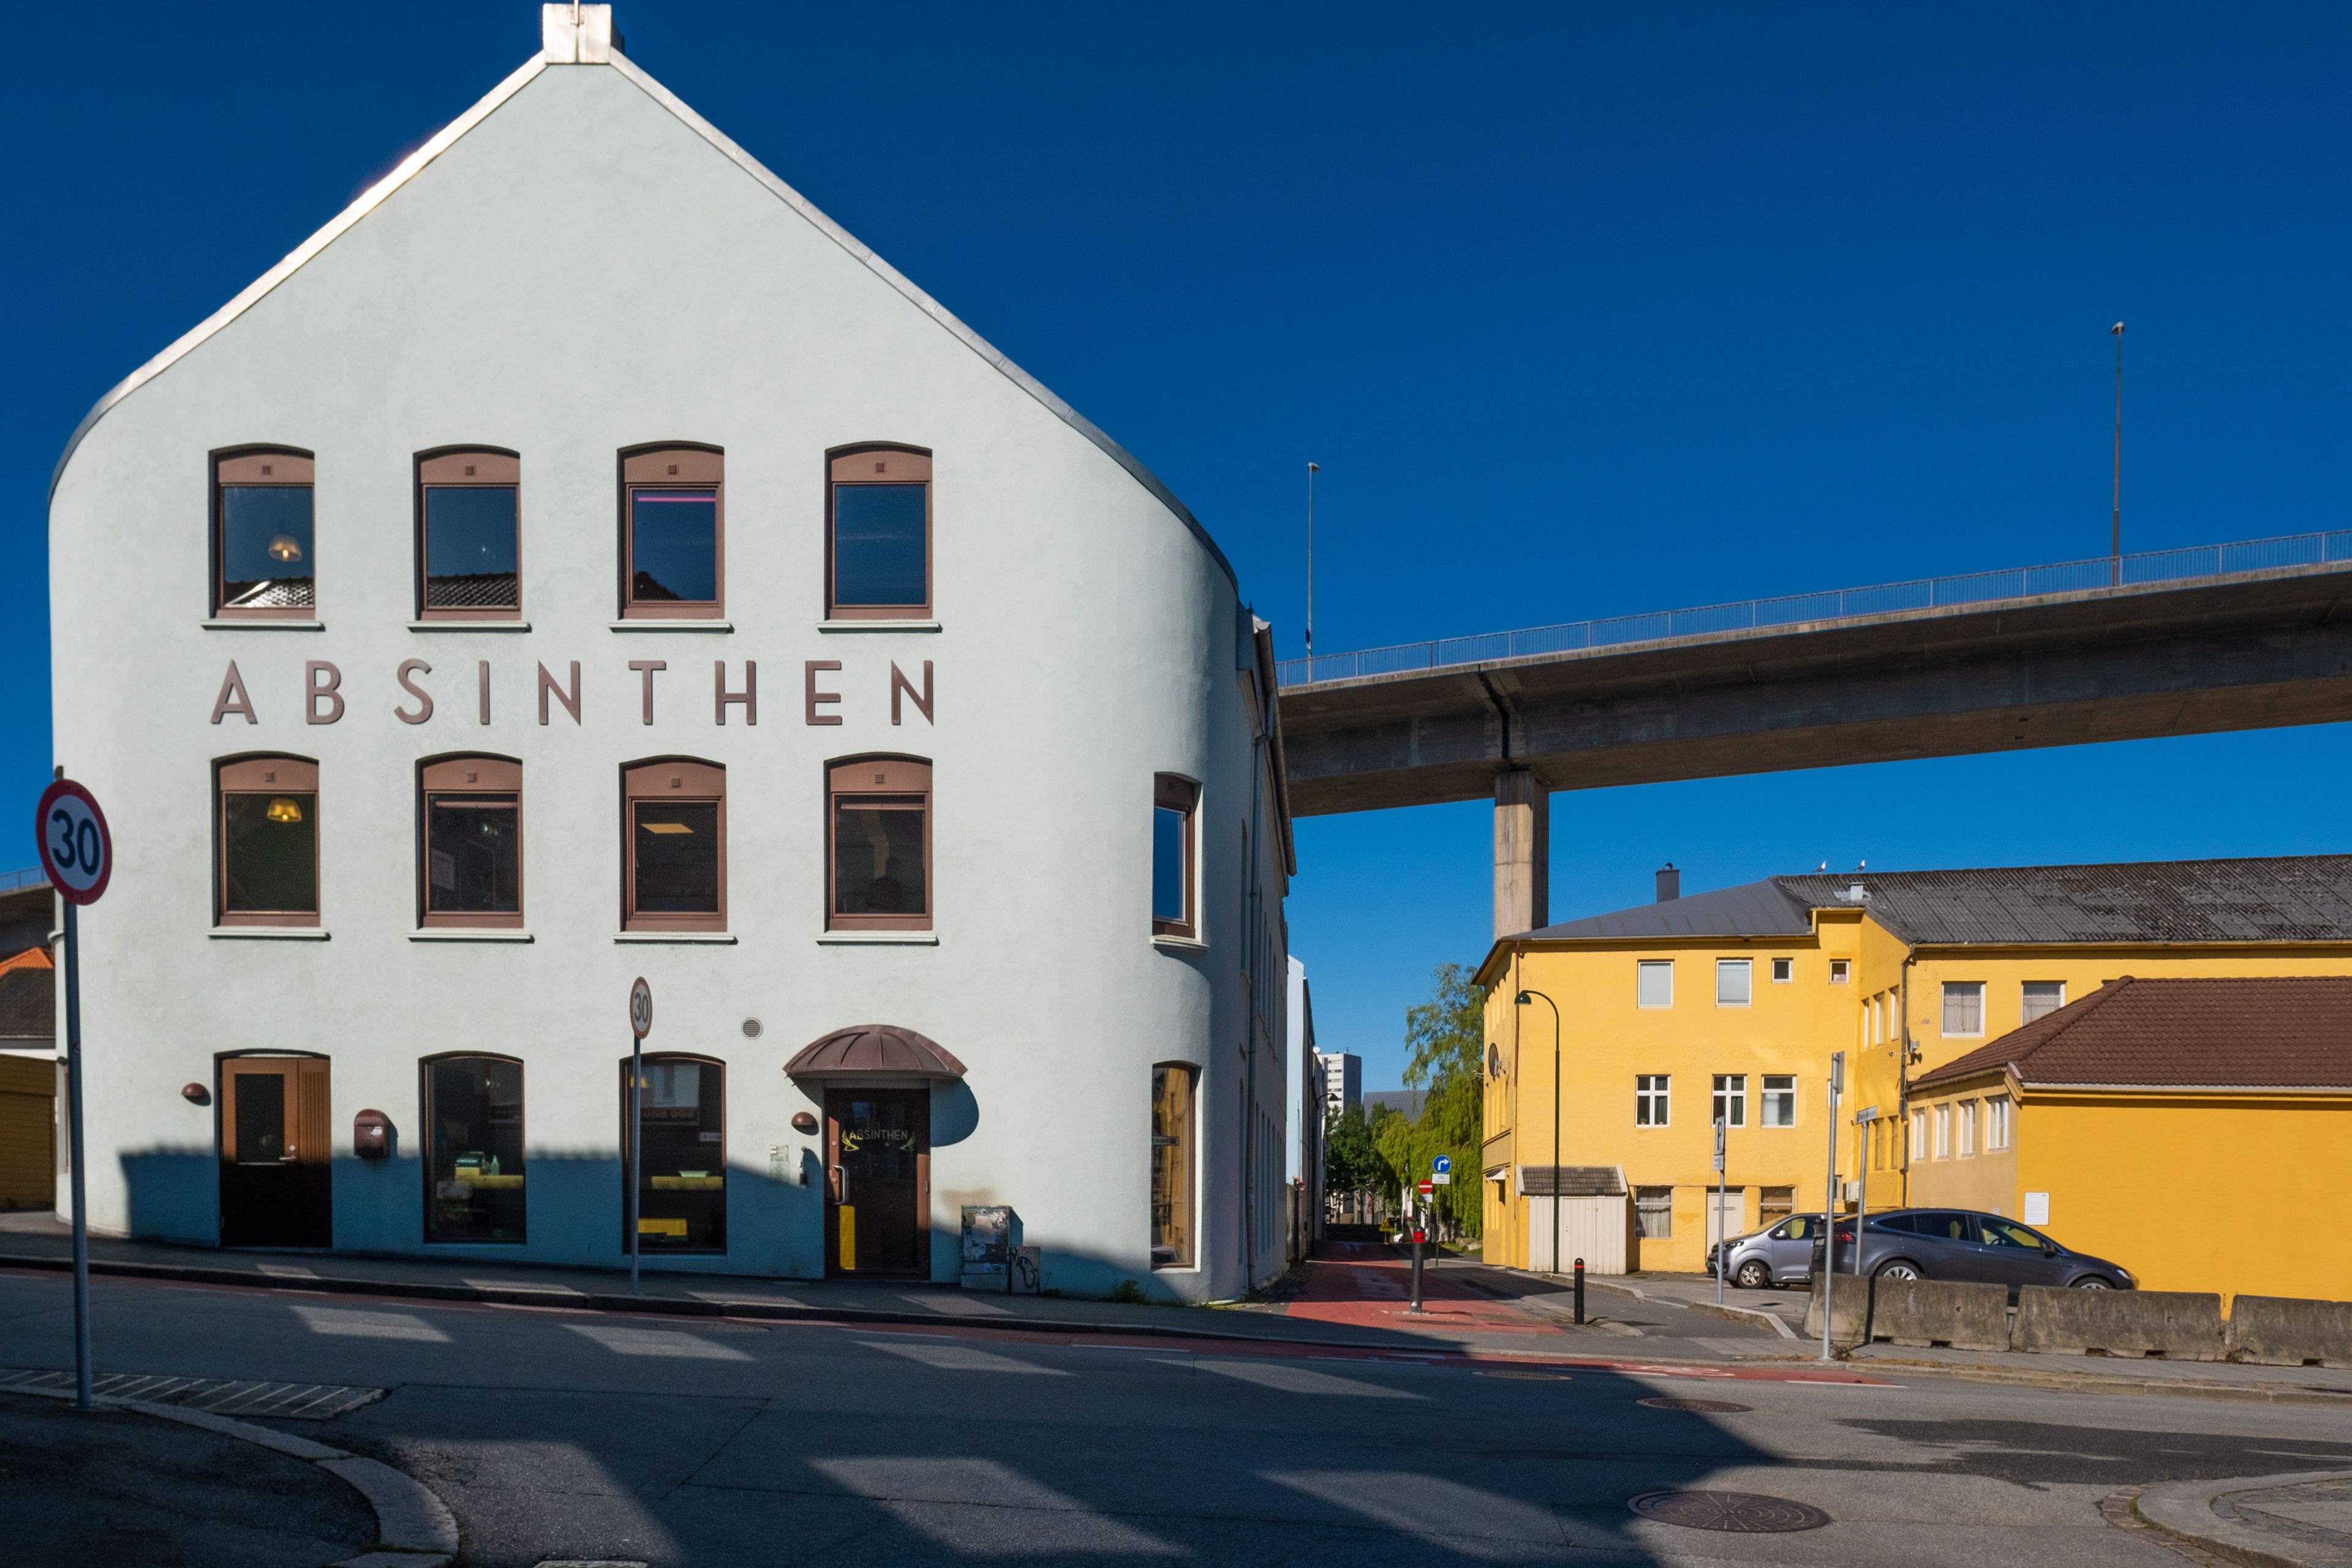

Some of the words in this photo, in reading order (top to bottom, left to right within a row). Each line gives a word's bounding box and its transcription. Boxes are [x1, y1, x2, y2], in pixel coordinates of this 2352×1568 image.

[210, 659, 934, 726] ABSINTHEN
[52, 809, 99, 875] 30
[634, 992, 649, 1023] 30
[849, 1129, 907, 1140] ABSINTHEN
